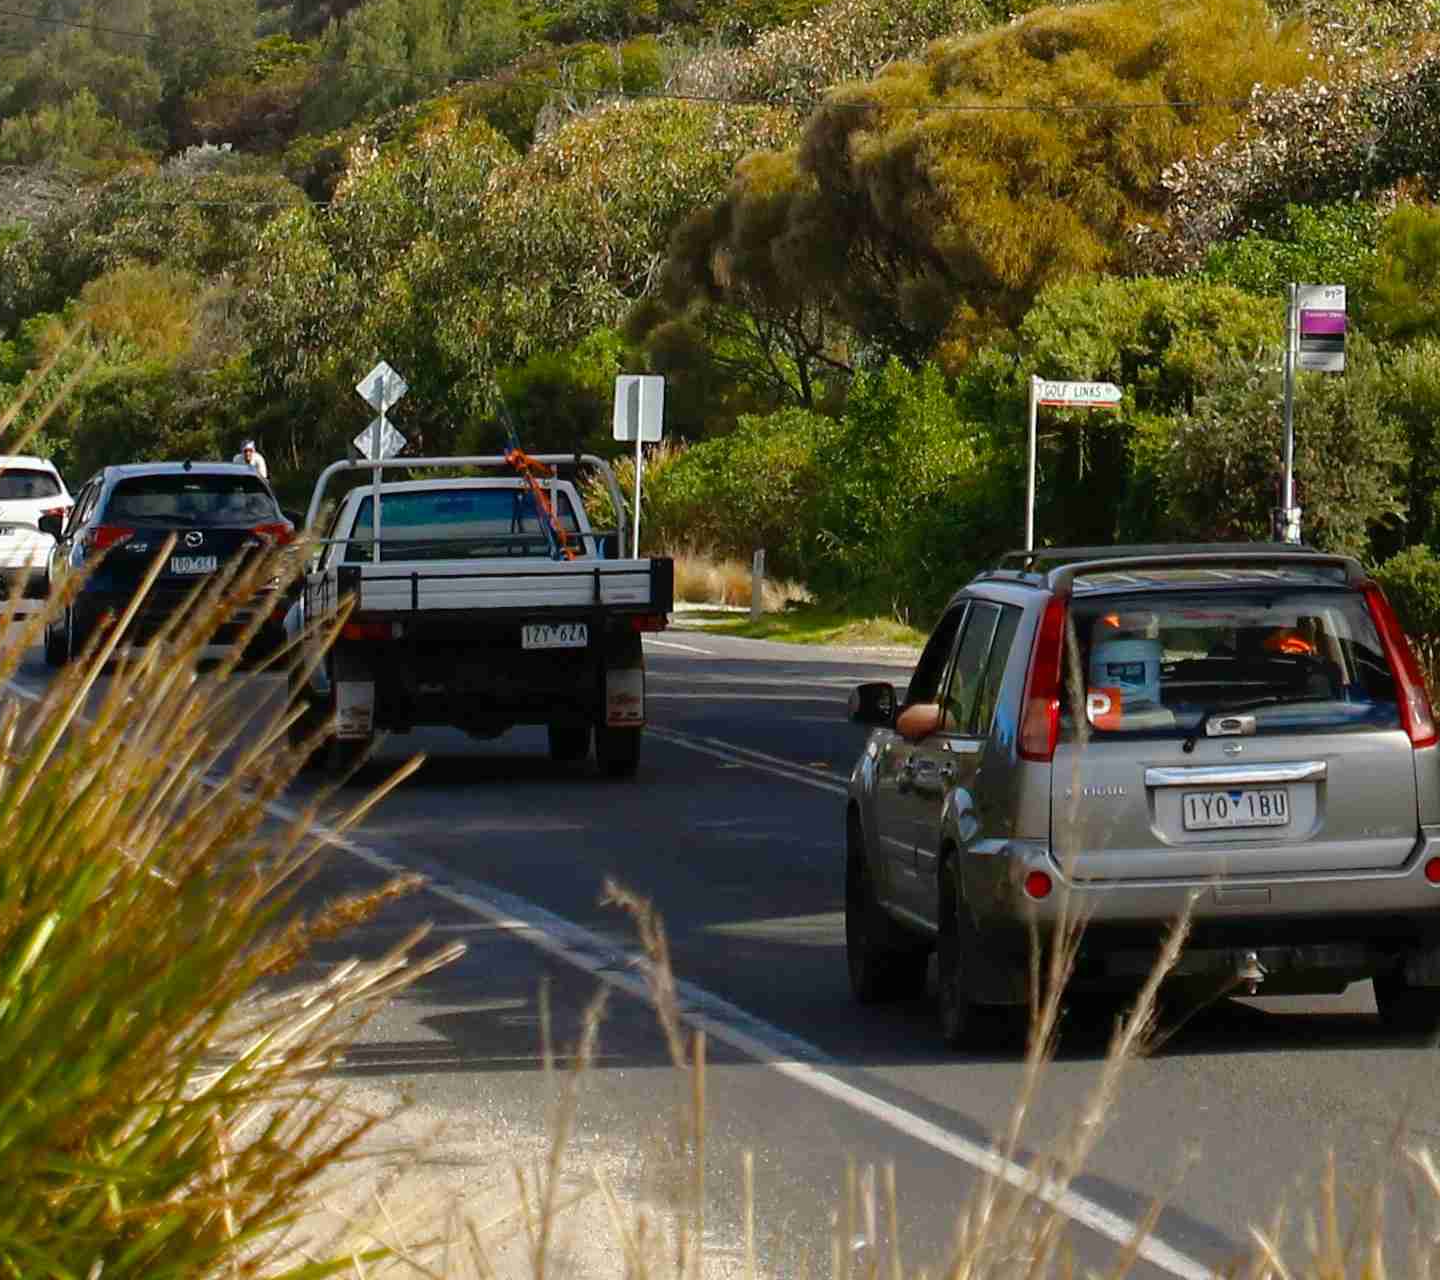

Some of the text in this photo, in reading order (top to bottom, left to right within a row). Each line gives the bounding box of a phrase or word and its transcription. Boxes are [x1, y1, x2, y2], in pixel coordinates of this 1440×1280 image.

[1044, 383, 1067, 398] GOLF
[1073, 384, 1102, 398] LINKS
[1086, 692, 1112, 725] P
[1190, 793, 1286, 821] 1YO 1BU
